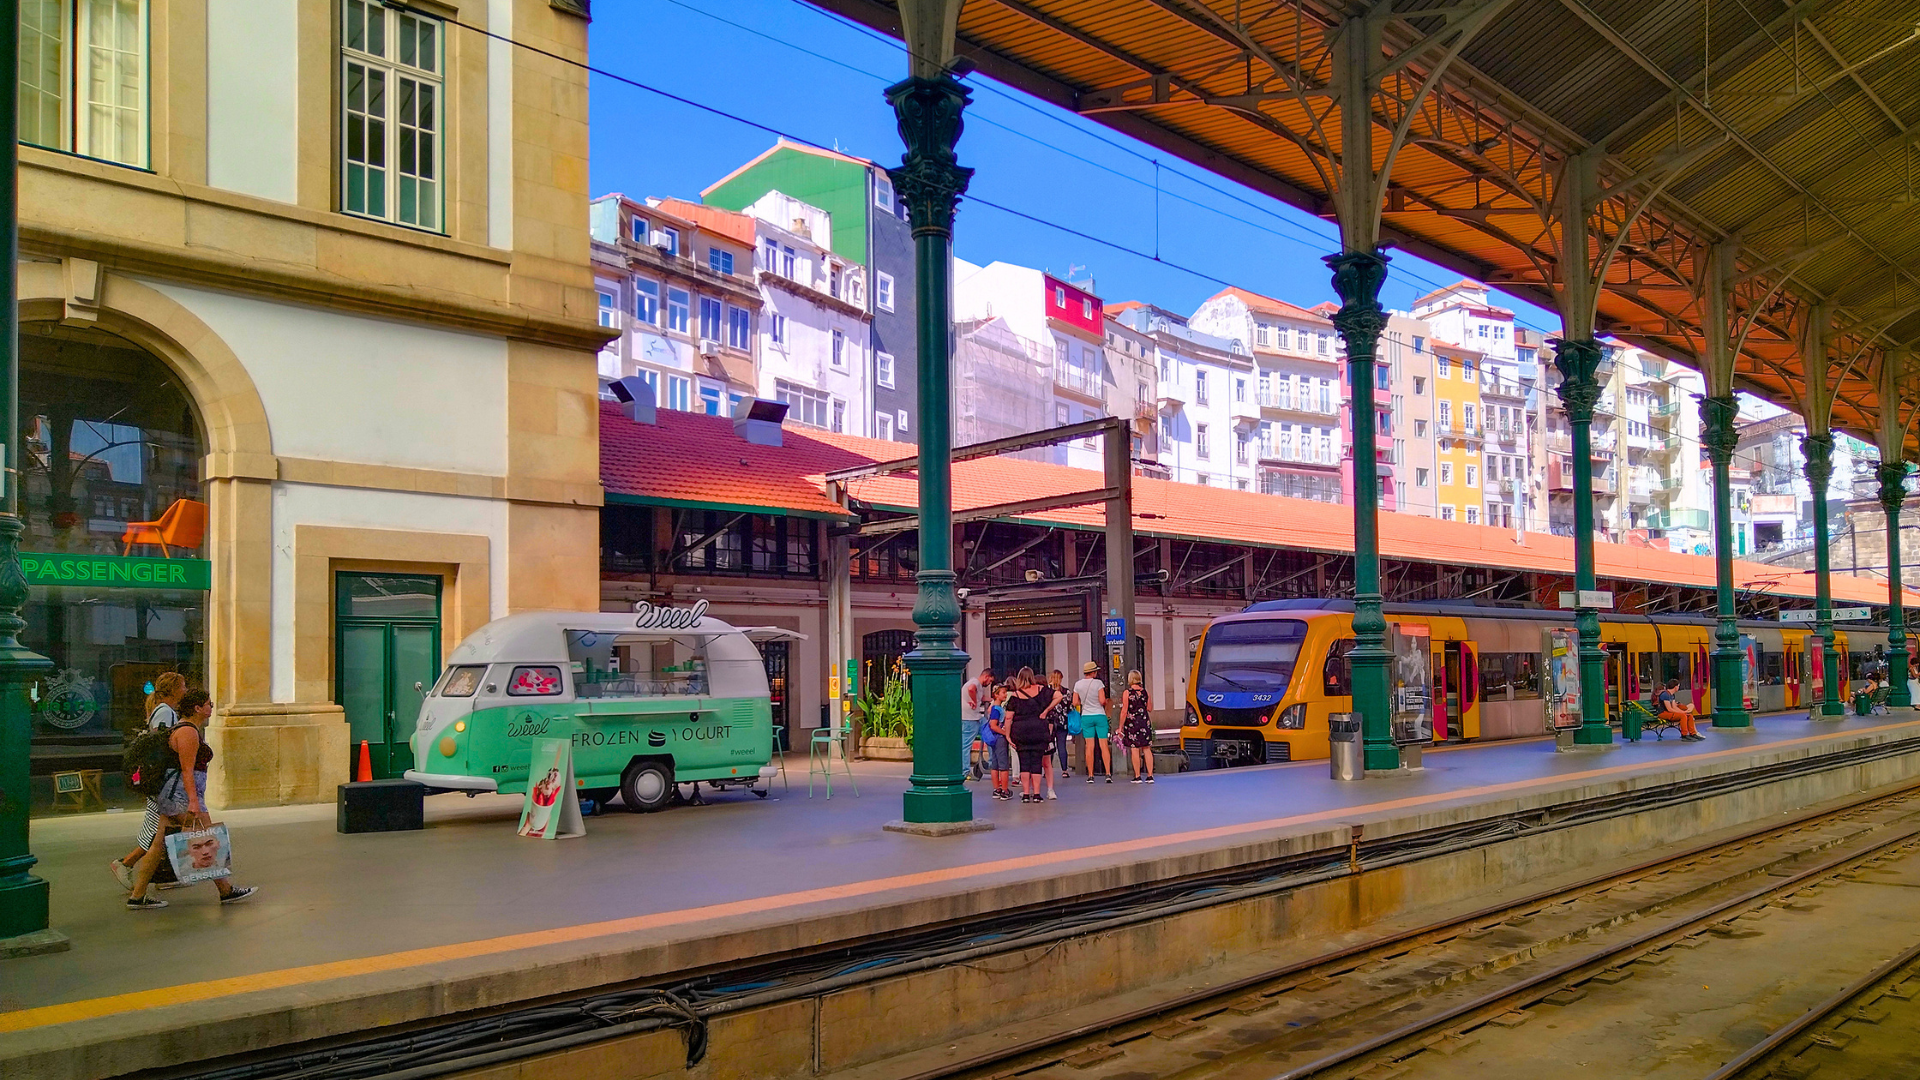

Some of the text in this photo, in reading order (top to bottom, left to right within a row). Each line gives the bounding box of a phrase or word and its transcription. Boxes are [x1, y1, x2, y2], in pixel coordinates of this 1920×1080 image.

[21, 559, 187, 583] PASSENGER
[1106, 627, 1121, 635] PRT1
[1253, 694, 1272, 702] 3432
[571, 731, 639, 747] FROZEN
[672, 725, 732, 742] YOGURT
[731, 747, 756, 756] #weeel
[176, 826, 225, 842] BERSHKA
[182, 867, 231, 884] BERSHKA
